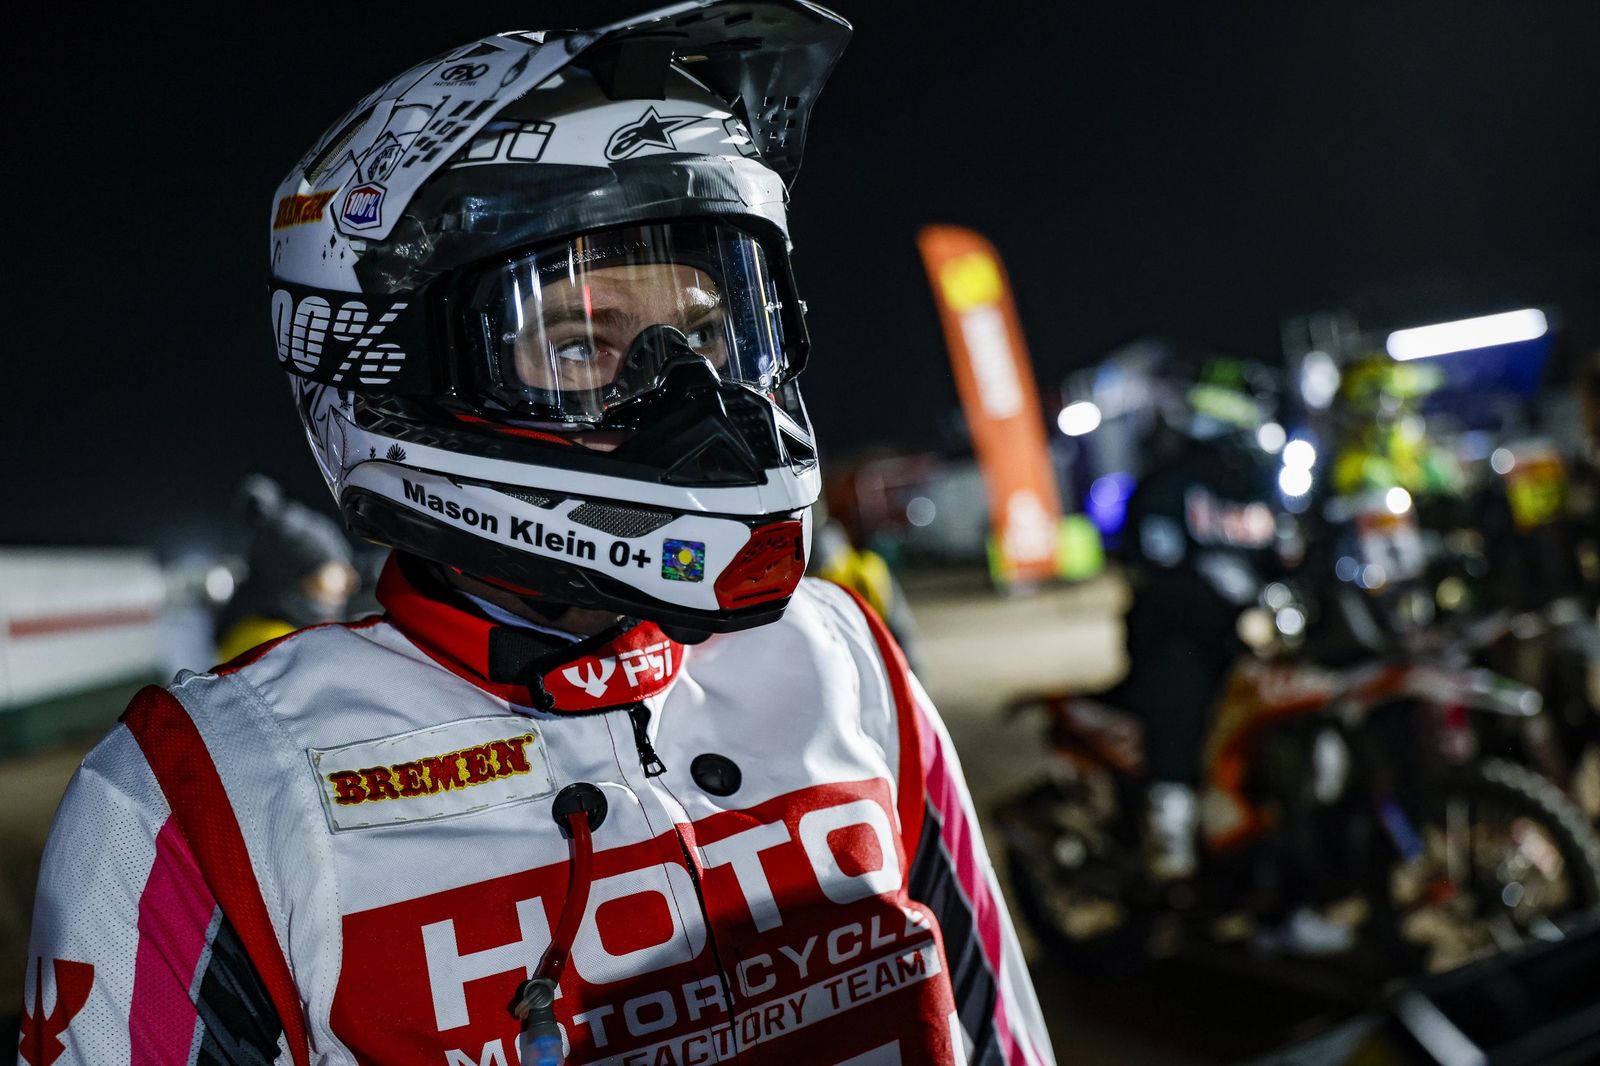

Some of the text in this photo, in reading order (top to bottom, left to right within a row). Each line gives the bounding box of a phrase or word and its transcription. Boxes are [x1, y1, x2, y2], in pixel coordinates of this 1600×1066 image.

[346, 192, 379, 218] 100%
[402, 478, 652, 568] Mason Klein 0+
[327, 733, 535, 806] BREMEN
[421, 799, 903, 1032] HOTO
[444, 906, 931, 1066] MTORCYCLE
[824, 949, 926, 1010] TEAM
